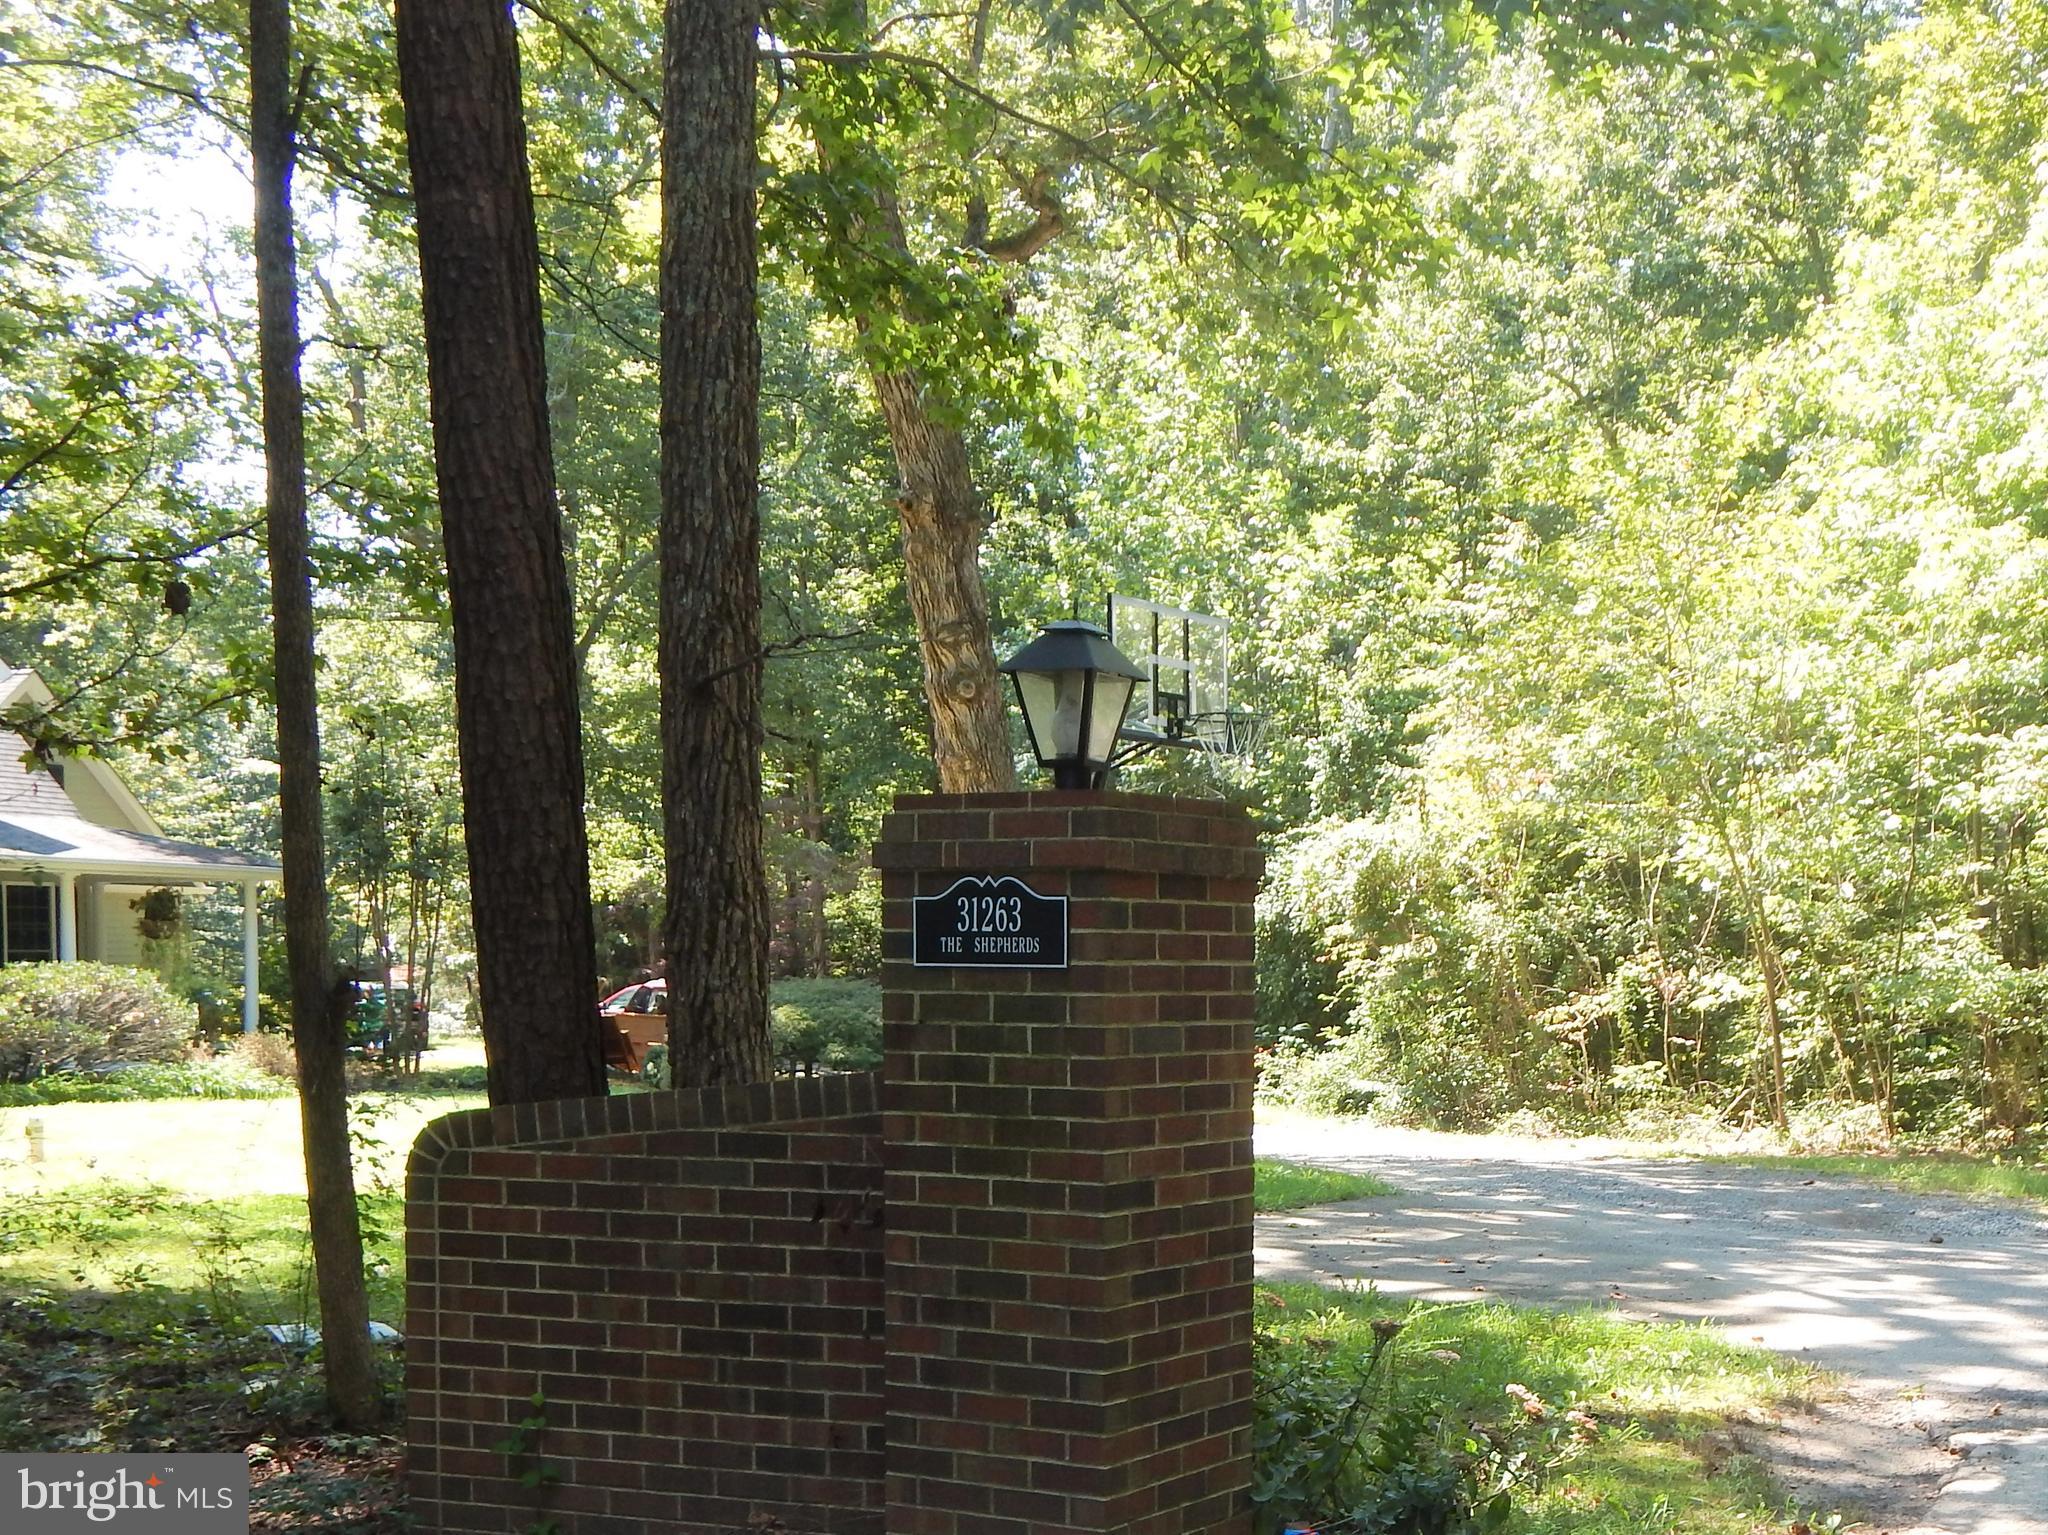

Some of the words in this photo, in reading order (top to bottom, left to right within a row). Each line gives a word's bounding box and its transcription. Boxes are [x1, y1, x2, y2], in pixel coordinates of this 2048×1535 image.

[957, 896, 1022, 932] 31263
[940, 936, 963, 953] THE
[974, 936, 1040, 953] SHEPHERDS
